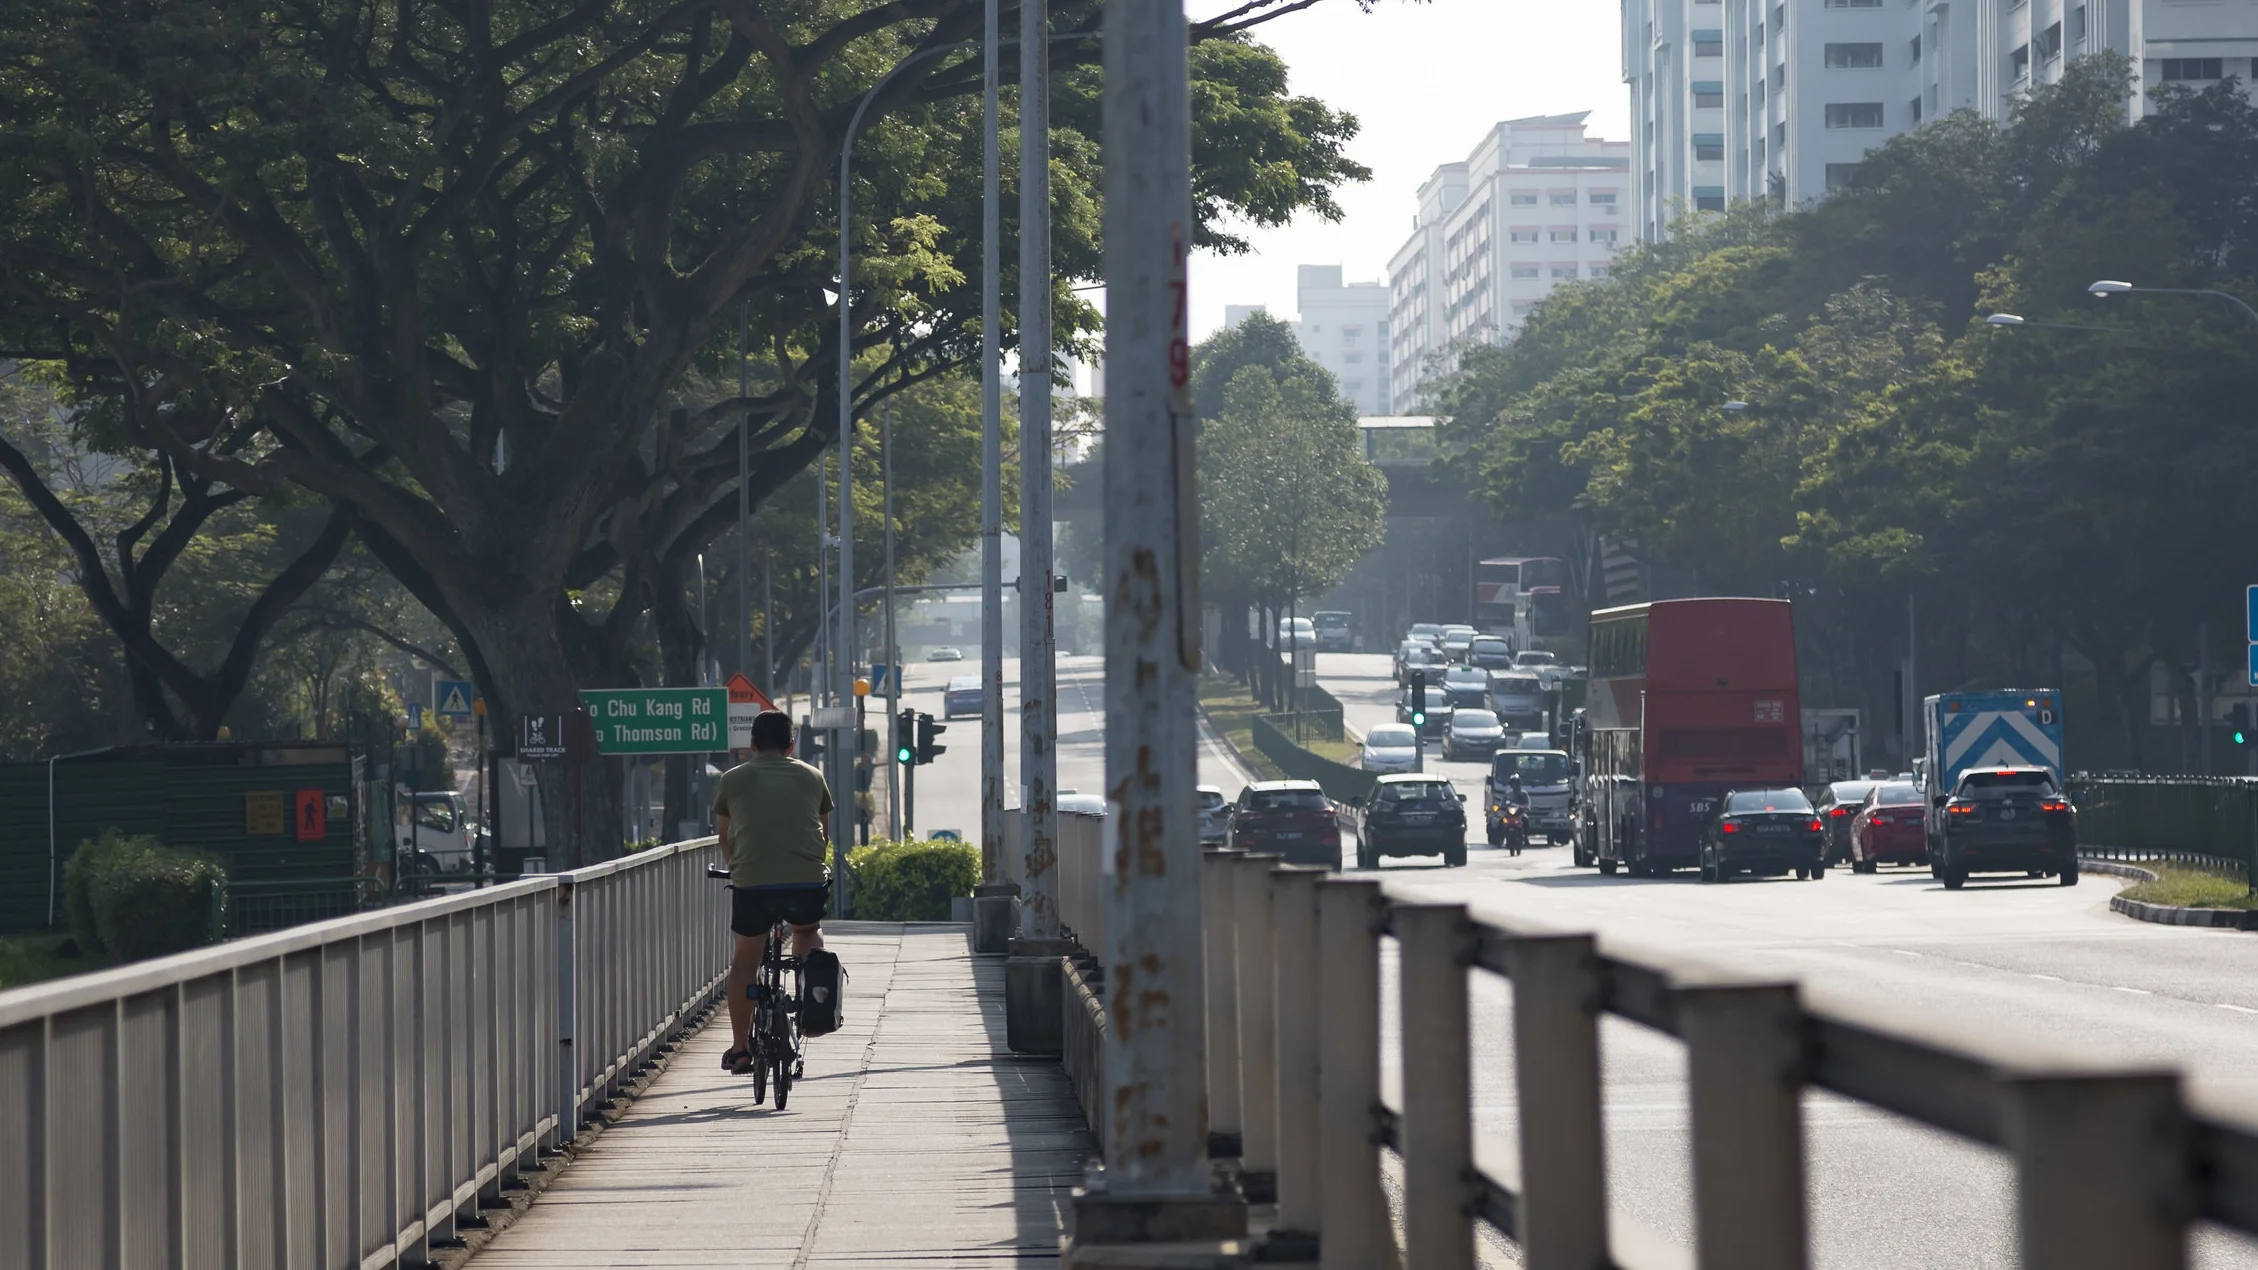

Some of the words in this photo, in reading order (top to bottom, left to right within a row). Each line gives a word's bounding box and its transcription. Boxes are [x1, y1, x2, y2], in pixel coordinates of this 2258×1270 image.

[1168, 220, 1189, 388] 179
[1045, 569, 1053, 635] 181
[607, 699, 637, 717] Chu
[645, 698, 683, 719] Kang
[691, 697, 711, 715] Rd
[2042, 709, 2053, 724] D
[613, 725, 682, 743] Thomson
[691, 721, 718, 741] Rd)
